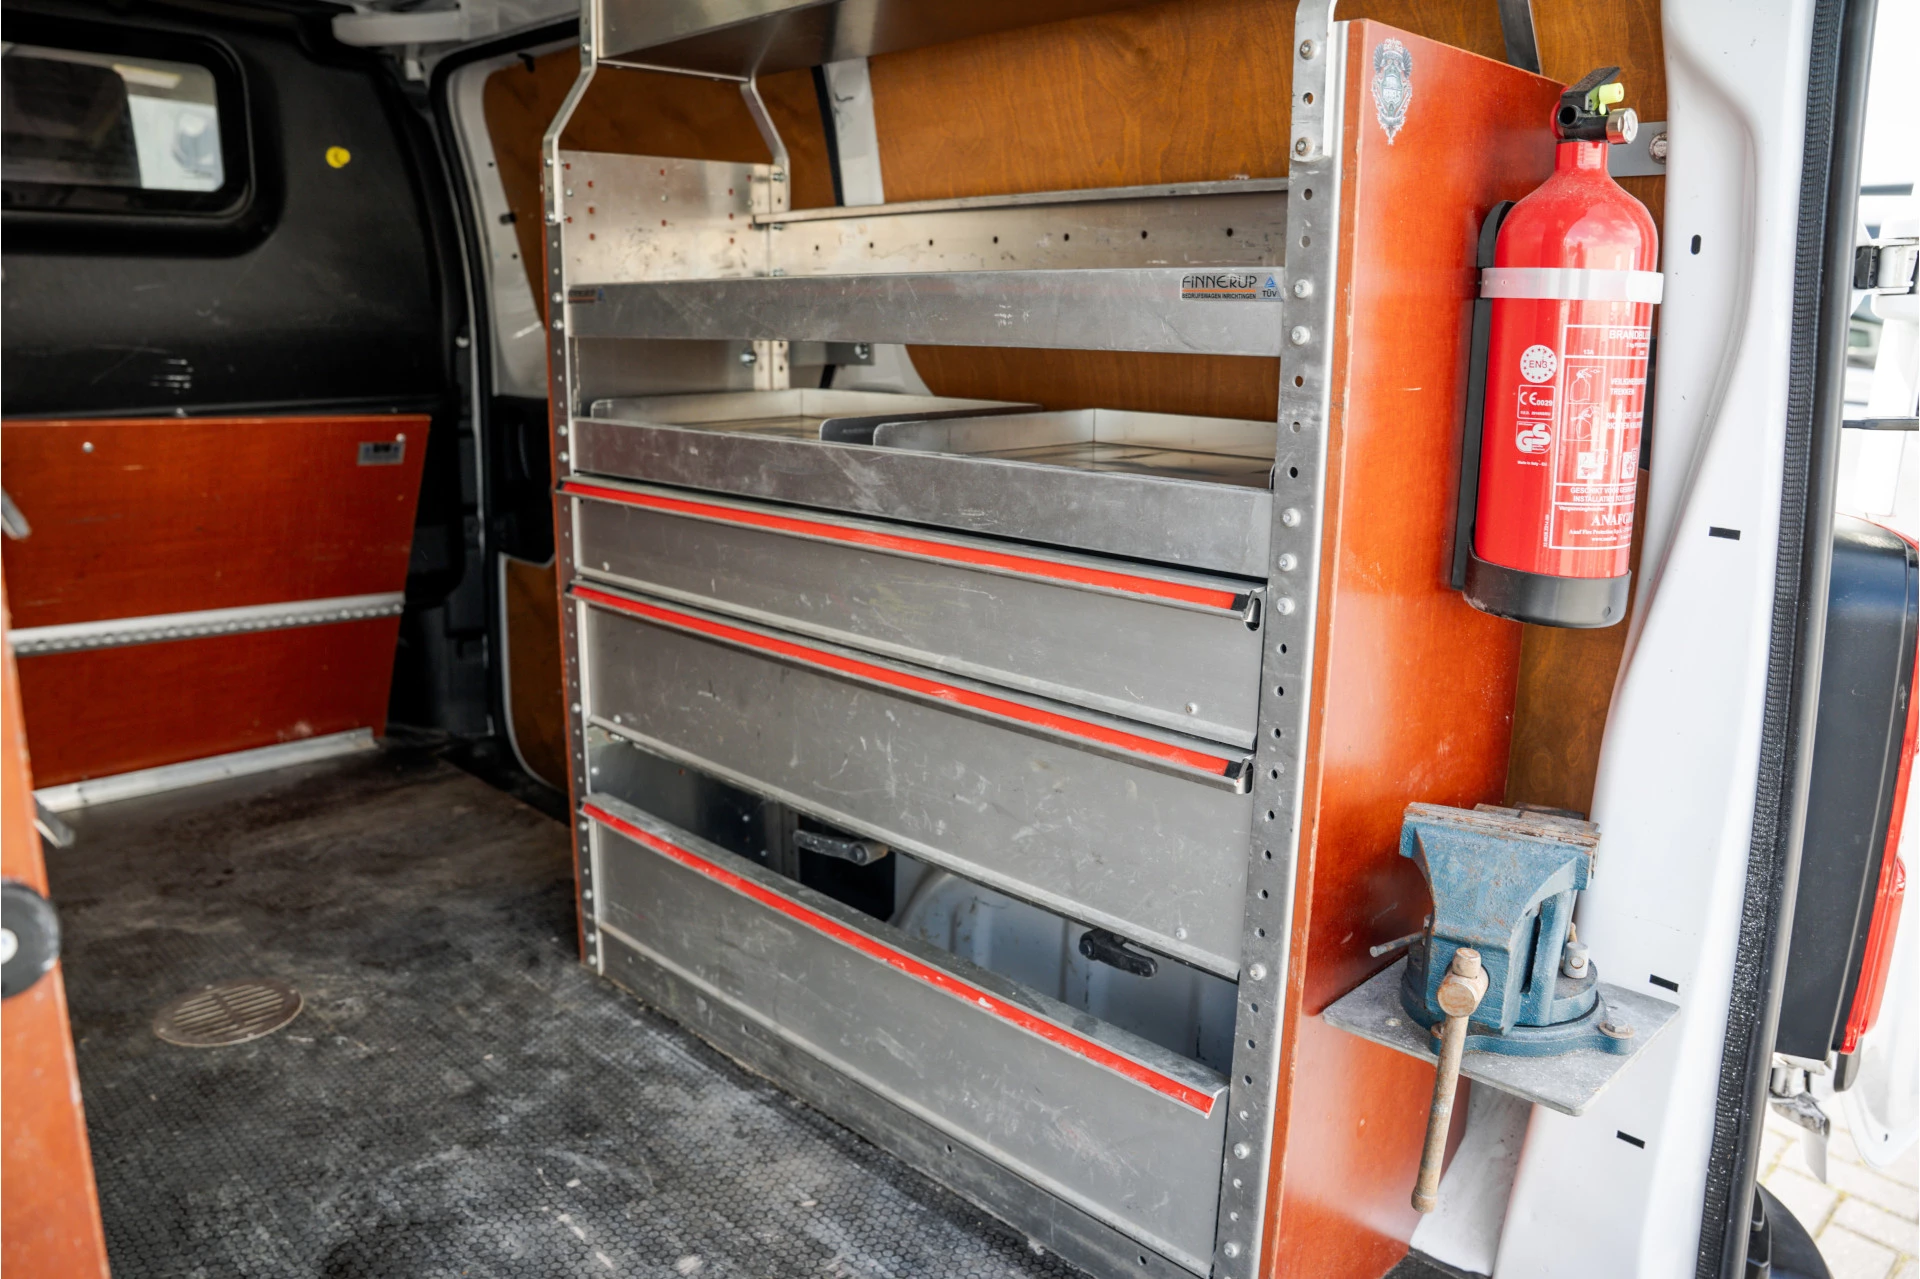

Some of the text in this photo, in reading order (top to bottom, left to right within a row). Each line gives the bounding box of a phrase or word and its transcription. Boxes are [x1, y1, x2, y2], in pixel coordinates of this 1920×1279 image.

[1262, 289, 1278, 298] TÜV
[1529, 360, 1548, 368] EN3
[1516, 423, 1551, 452] GS
